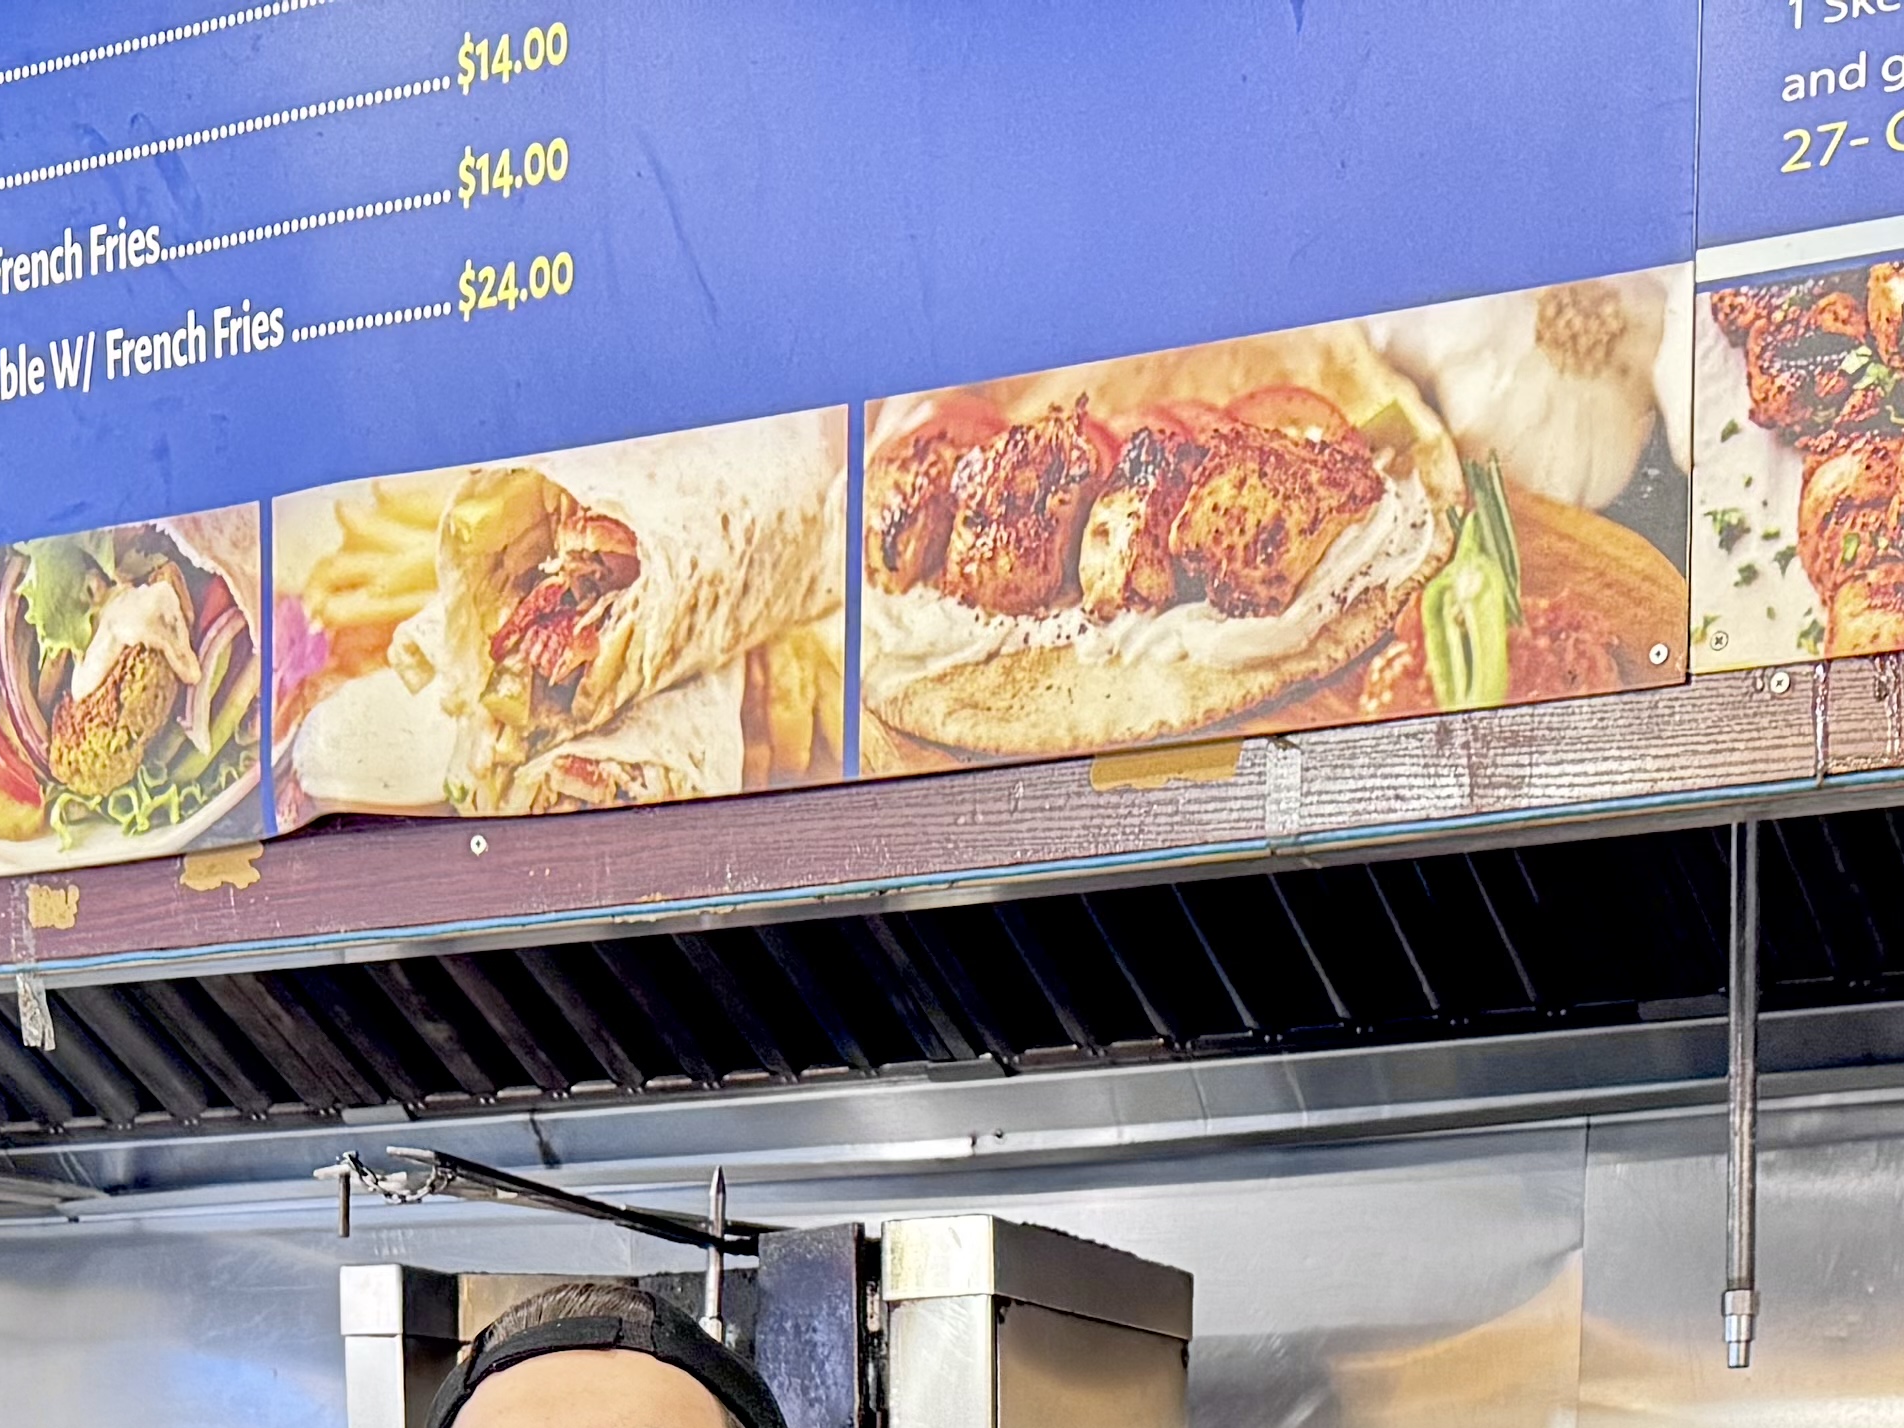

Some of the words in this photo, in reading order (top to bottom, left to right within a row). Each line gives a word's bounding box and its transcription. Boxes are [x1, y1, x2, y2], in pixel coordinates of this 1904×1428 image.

[458, 22, 568, 95] $14.00
[1782, 51, 1867, 101] and
[458, 138, 569, 209] $14.00
[1781, 121, 1870, 172] 27-
[90, 224, 161, 275] Fries
[459, 252, 574, 322] $24.00
[50, 331, 95, 392] W/
[106, 310, 207, 379] French
[214, 306, 285, 358] Fries
